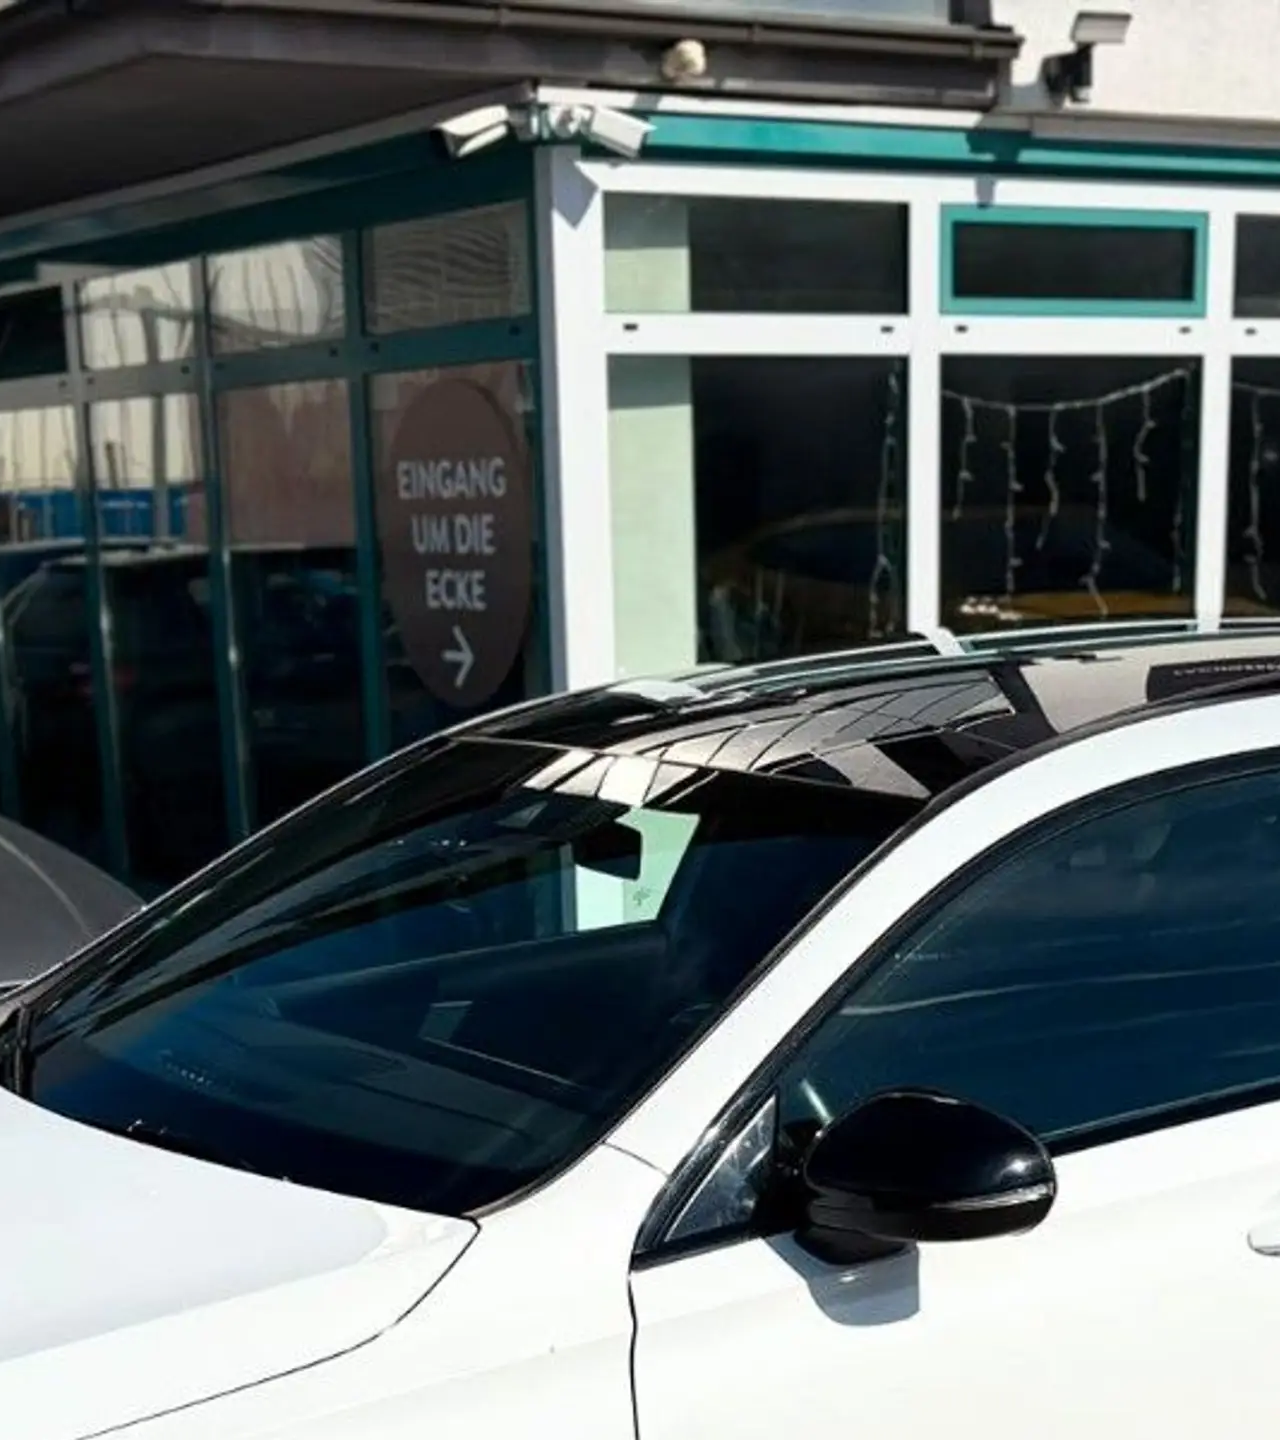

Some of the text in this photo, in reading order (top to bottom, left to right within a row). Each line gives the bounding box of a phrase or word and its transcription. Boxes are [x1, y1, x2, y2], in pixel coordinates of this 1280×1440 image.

[396, 456, 507, 499] EINGANG
[411, 513, 496, 555] UM DIE
[425, 568, 487, 611] ECKE
